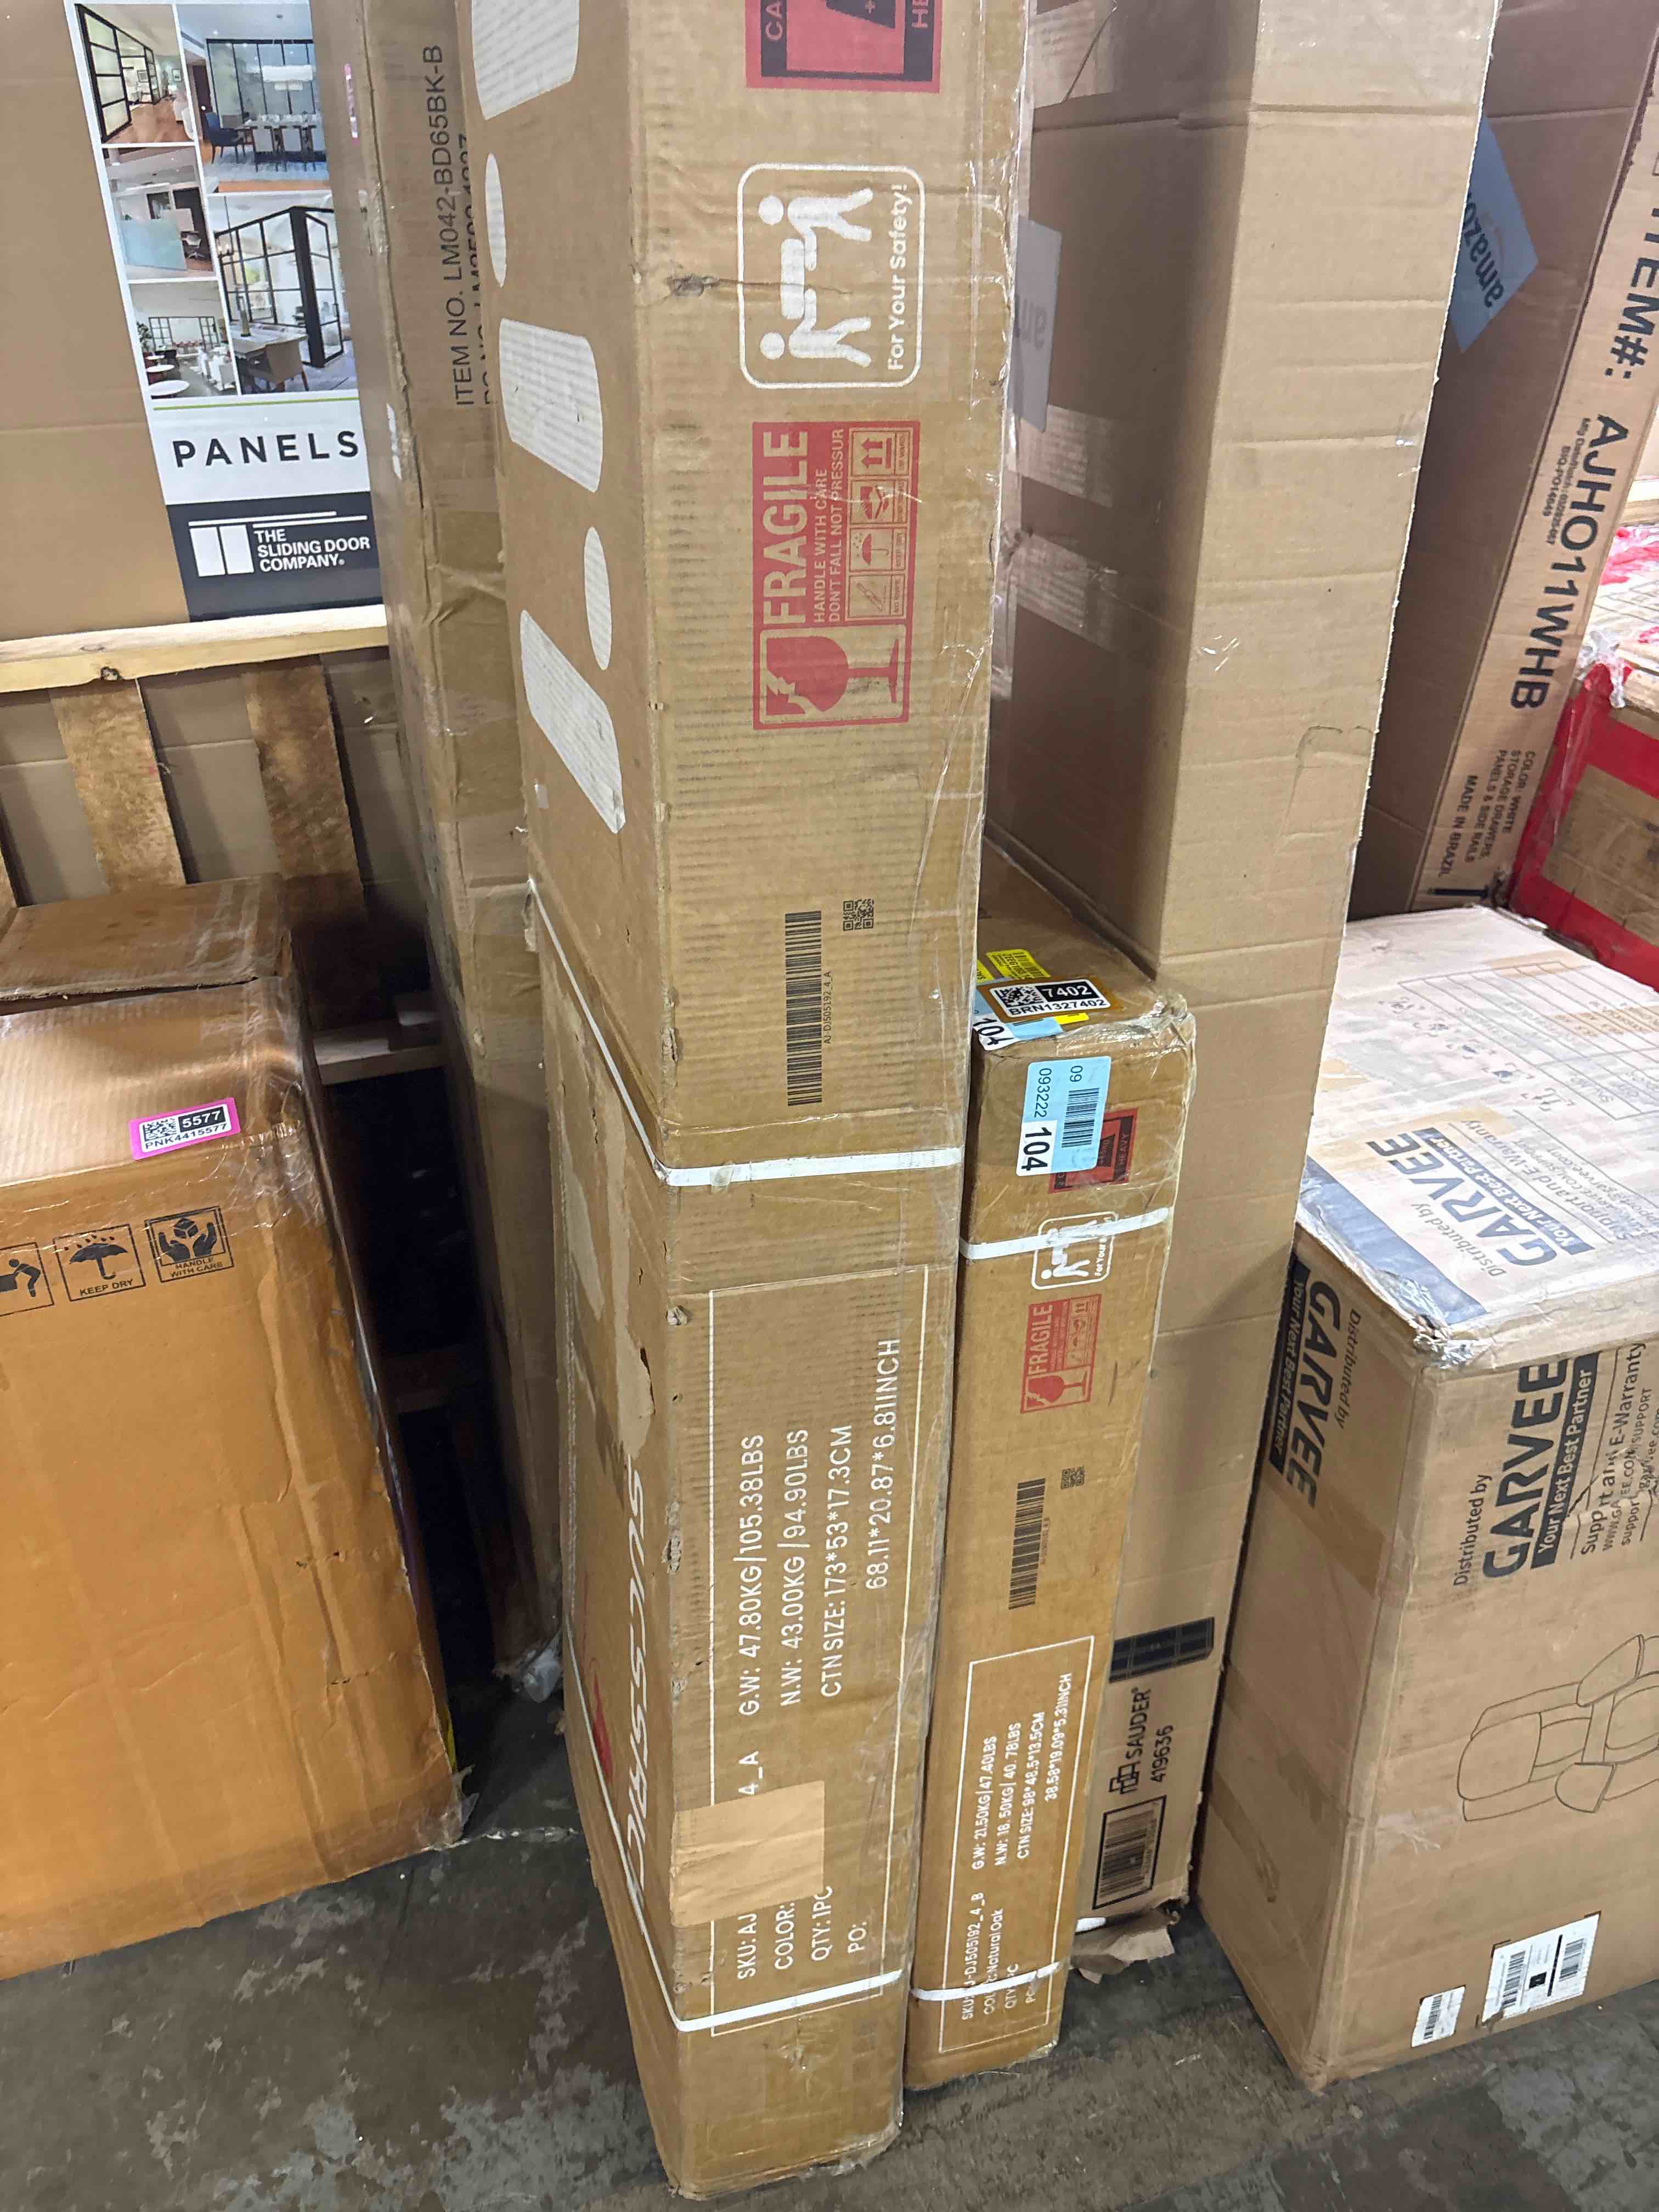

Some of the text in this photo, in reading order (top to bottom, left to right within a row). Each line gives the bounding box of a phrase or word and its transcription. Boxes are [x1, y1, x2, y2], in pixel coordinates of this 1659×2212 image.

[422, 44, 474, 405] ITEM NO. LM042-BD65BK-B
[1463, 192, 1505, 309] amazo
[888, 184, 913, 371] For Your Safety!
[1604, 208, 1659, 379] EM#:
[173, 431, 359, 467] PANELS
[254, 529, 286, 543] THE
[258, 537, 370, 558] SLIDING DOOR
[763, 431, 809, 625] FRAGILE
[814, 469, 827, 624] HANDLE WITH CARE
[829, 428, 844, 623] DON'T FALL NOT PRESSUR
[1451, 814, 1466, 831] IN
[1455, 773, 1479, 815] MADE
[1500, 793, 1522, 836] WHITE
[1007, 998, 1107, 1016] BRN1327402
[1042, 985, 1093, 998] 7402
[1070, 1065, 1084, 1082] 09
[145, 1122, 228, 1150] PNK4415577
[182, 1110, 222, 1129] 5577
[1021, 1068, 1052, 1171] 093222 104
[1365, 1130, 1558, 1267] GARVEE
[1431, 1136, 1574, 1246] Your Next Best Partner
[1460, 1119, 1629, 1240] Support and E-Warranty
[1412, 1203, 1507, 1277] Distributed by
[79, 1278, 134, 1297] KEEP DRY
[171, 1268, 194, 1278] WITH
[1029, 1304, 1053, 1374] FRAGILE
[1273, 1282, 1305, 1454] Your Next Best Partner
[1334, 1308, 1361, 1429] Distributed by
[1286, 1280, 1341, 1510] GARVEE
[1483, 1358, 1568, 1578] GARVEE
[1538, 1369, 1593, 1553] Your Next Best Partner
[1581, 1488, 1613, 1556] Supprt
[1610, 1342, 1646, 1447] E-Warranty
[1453, 1474, 1492, 1586] Distributed by
[738, 1667, 761, 1717] G.W:
[781, 1658, 803, 1707] N.W:
[820, 1654, 843, 1697] CTN
[1150, 1724, 1173, 1783] 419636
[971, 1841, 986, 1870] G.W:
[995, 1837, 1009, 1866] N.W:
[1016, 1833, 1031, 1860] CTN
[737, 1939, 758, 1980] SKU:
[774, 1901, 795, 1971] COLOR:
[848, 1920, 868, 1954] PO:
[964, 1892, 986, 1991] J-DJ505192_4_B
